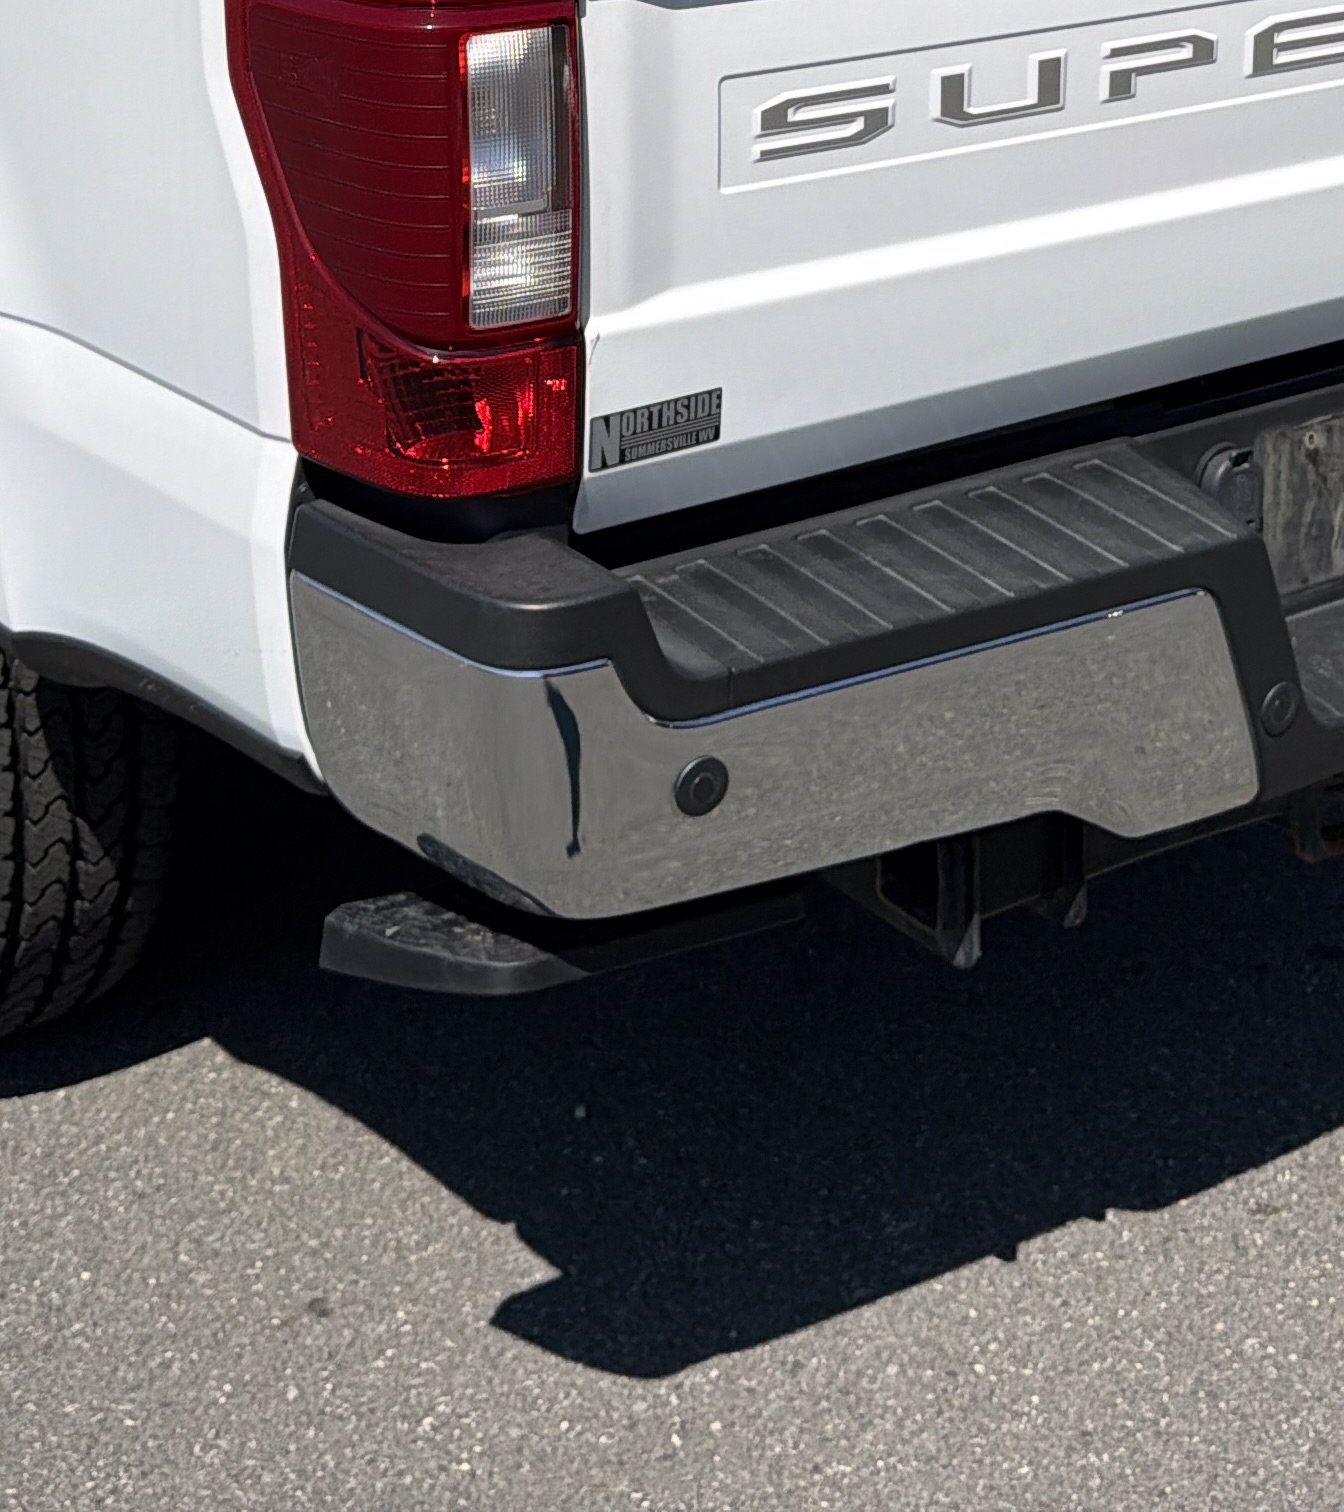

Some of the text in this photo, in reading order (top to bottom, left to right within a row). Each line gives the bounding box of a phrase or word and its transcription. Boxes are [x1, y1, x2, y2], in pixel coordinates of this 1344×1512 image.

[590, 390, 721, 471] NORTHSIDE
[624, 427, 716, 462] SUMMERSVILLE WV
